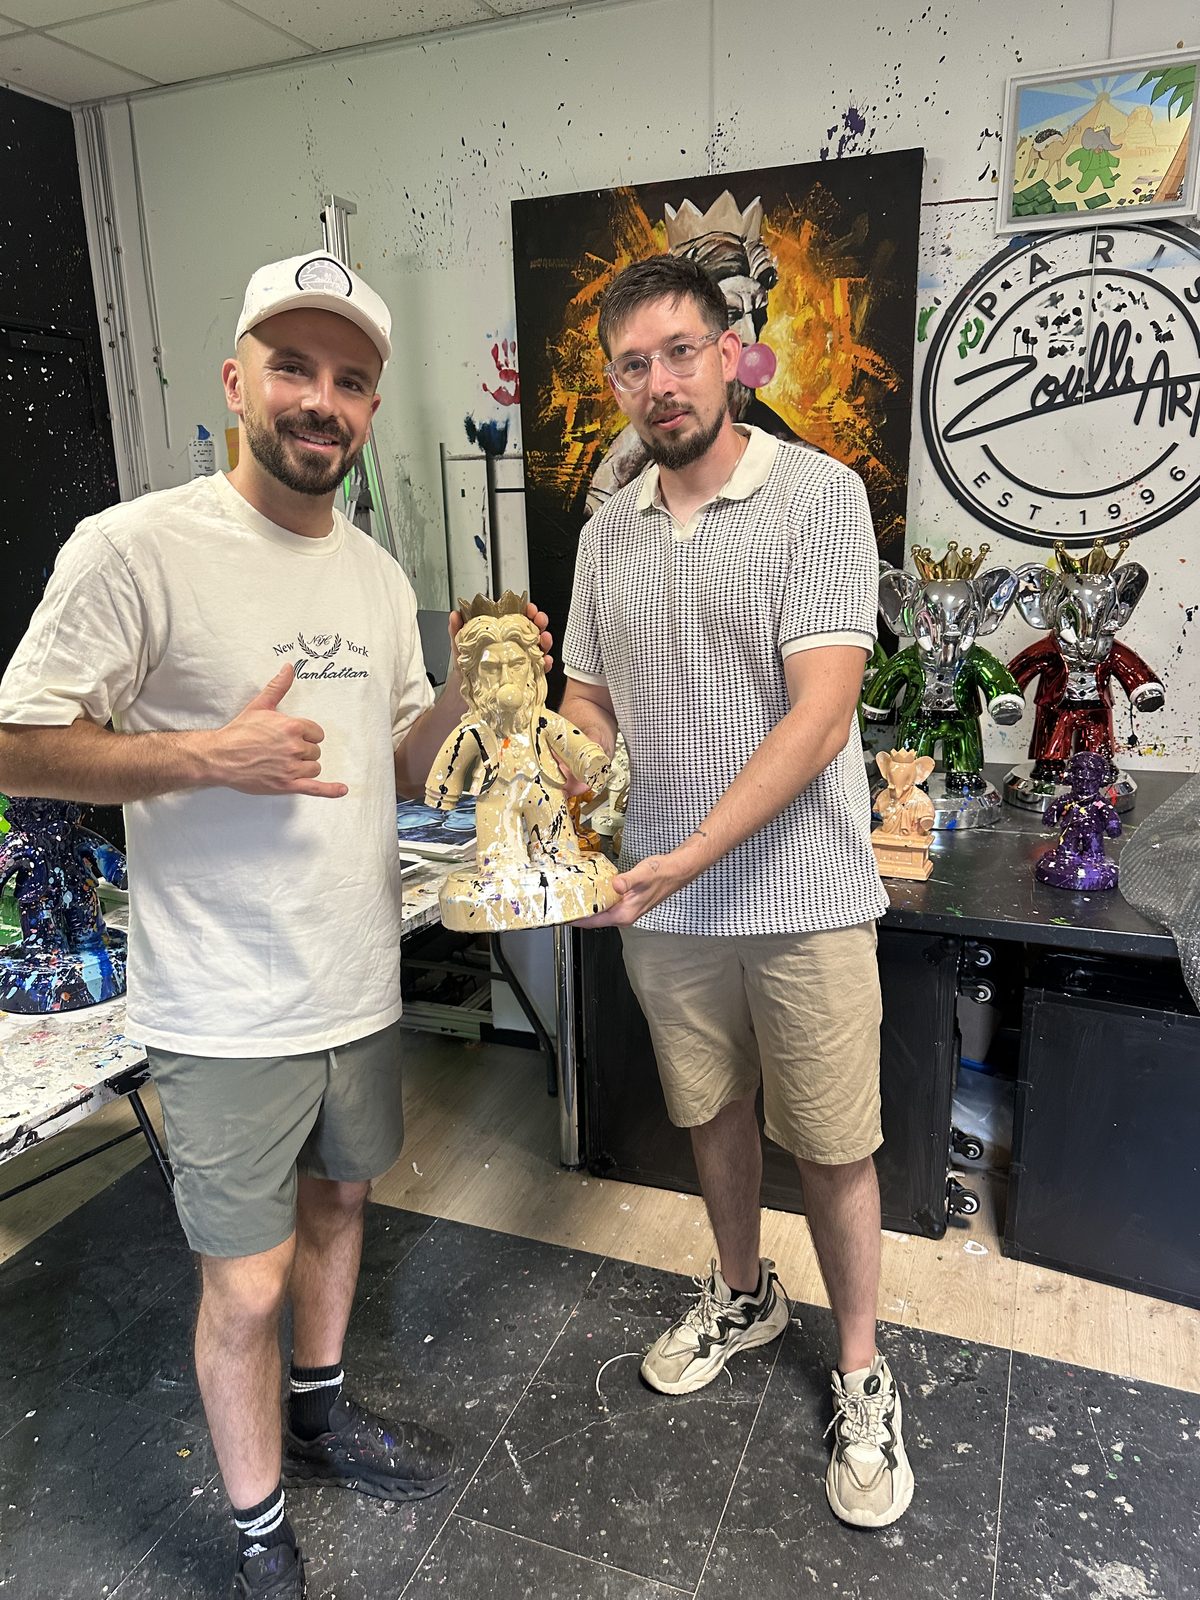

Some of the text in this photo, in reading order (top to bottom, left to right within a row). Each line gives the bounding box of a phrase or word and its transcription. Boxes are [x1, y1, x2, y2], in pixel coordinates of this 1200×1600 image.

[272, 640, 369, 658] New York
[294, 658, 369, 679] Manhattan
